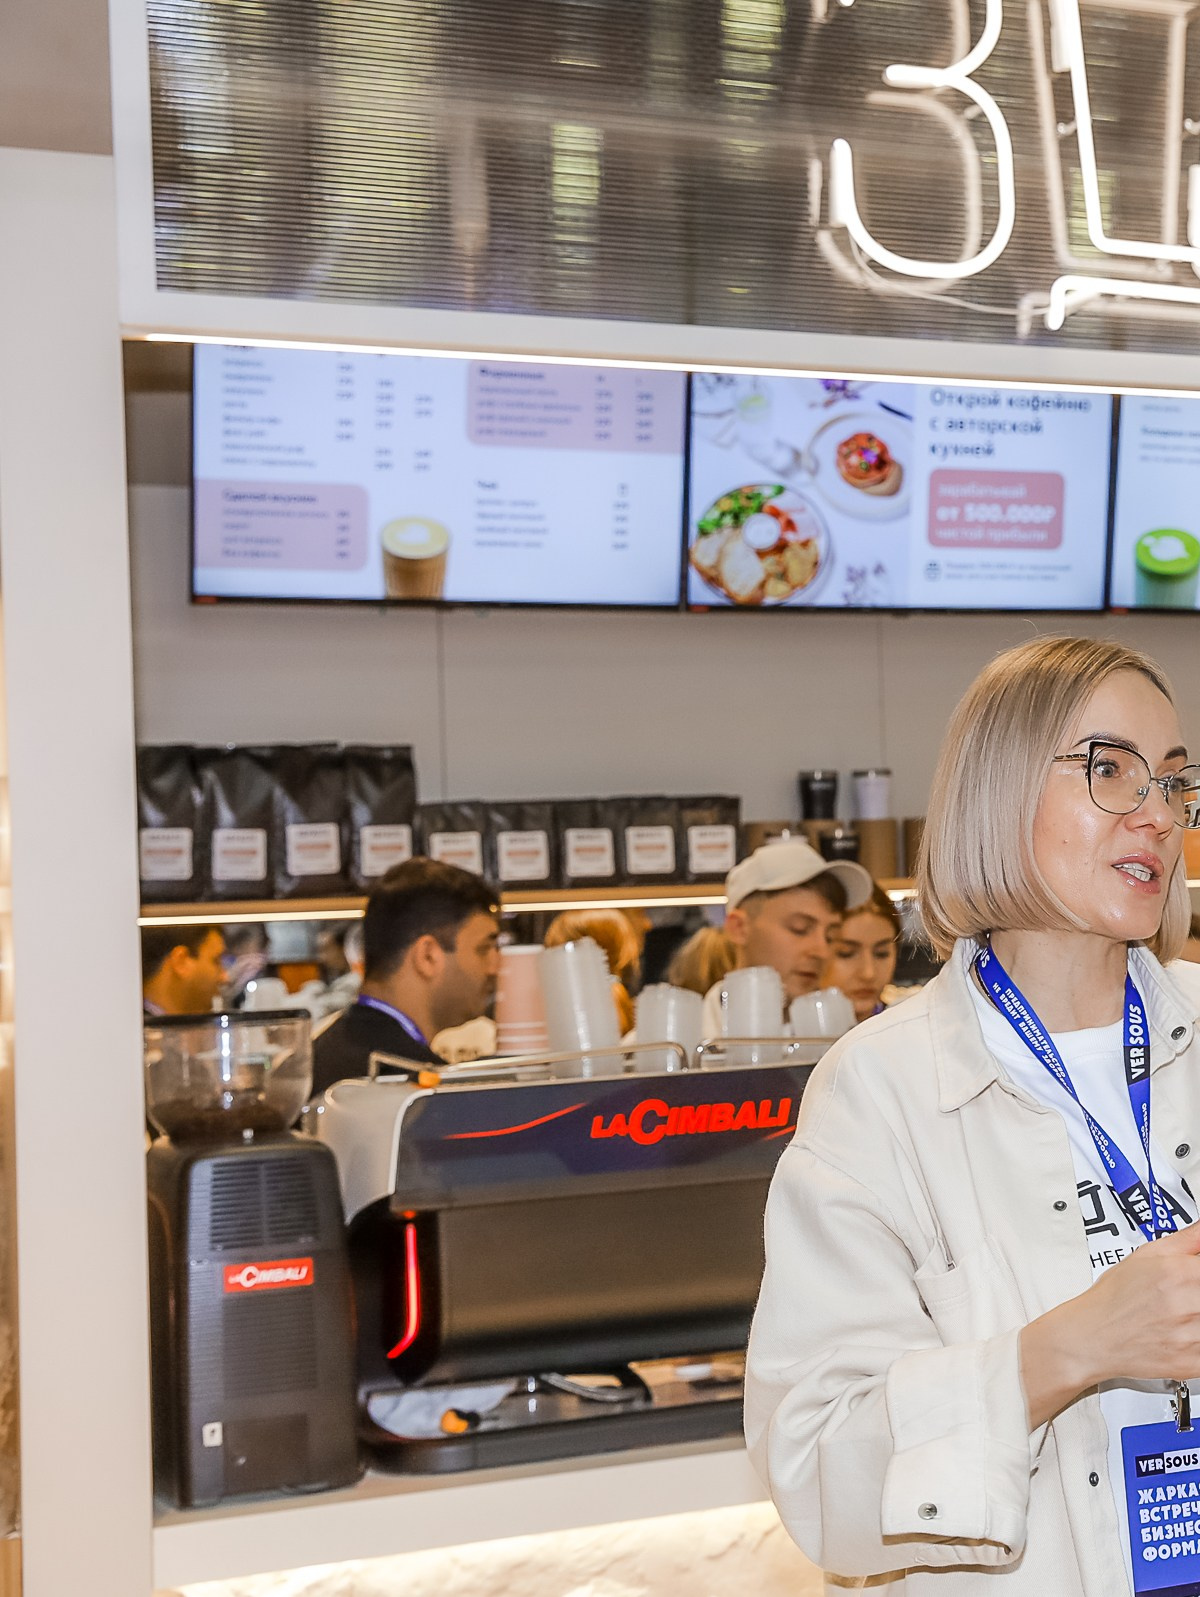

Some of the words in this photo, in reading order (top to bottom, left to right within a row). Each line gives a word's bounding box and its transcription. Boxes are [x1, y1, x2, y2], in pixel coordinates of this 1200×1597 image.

[991, 982, 1002, 994] НЕ
[999, 993, 1021, 1021] ВРЕДИТ
[1018, 1021, 1044, 1052] ВАШЕМУ
[1004, 987, 1067, 1078] ПРЕДПРИНИМАТЕЛЬСТВО
[1128, 1003, 1146, 1080] VERSOUS
[1139, 1453, 1200, 1473] VERSOUS
